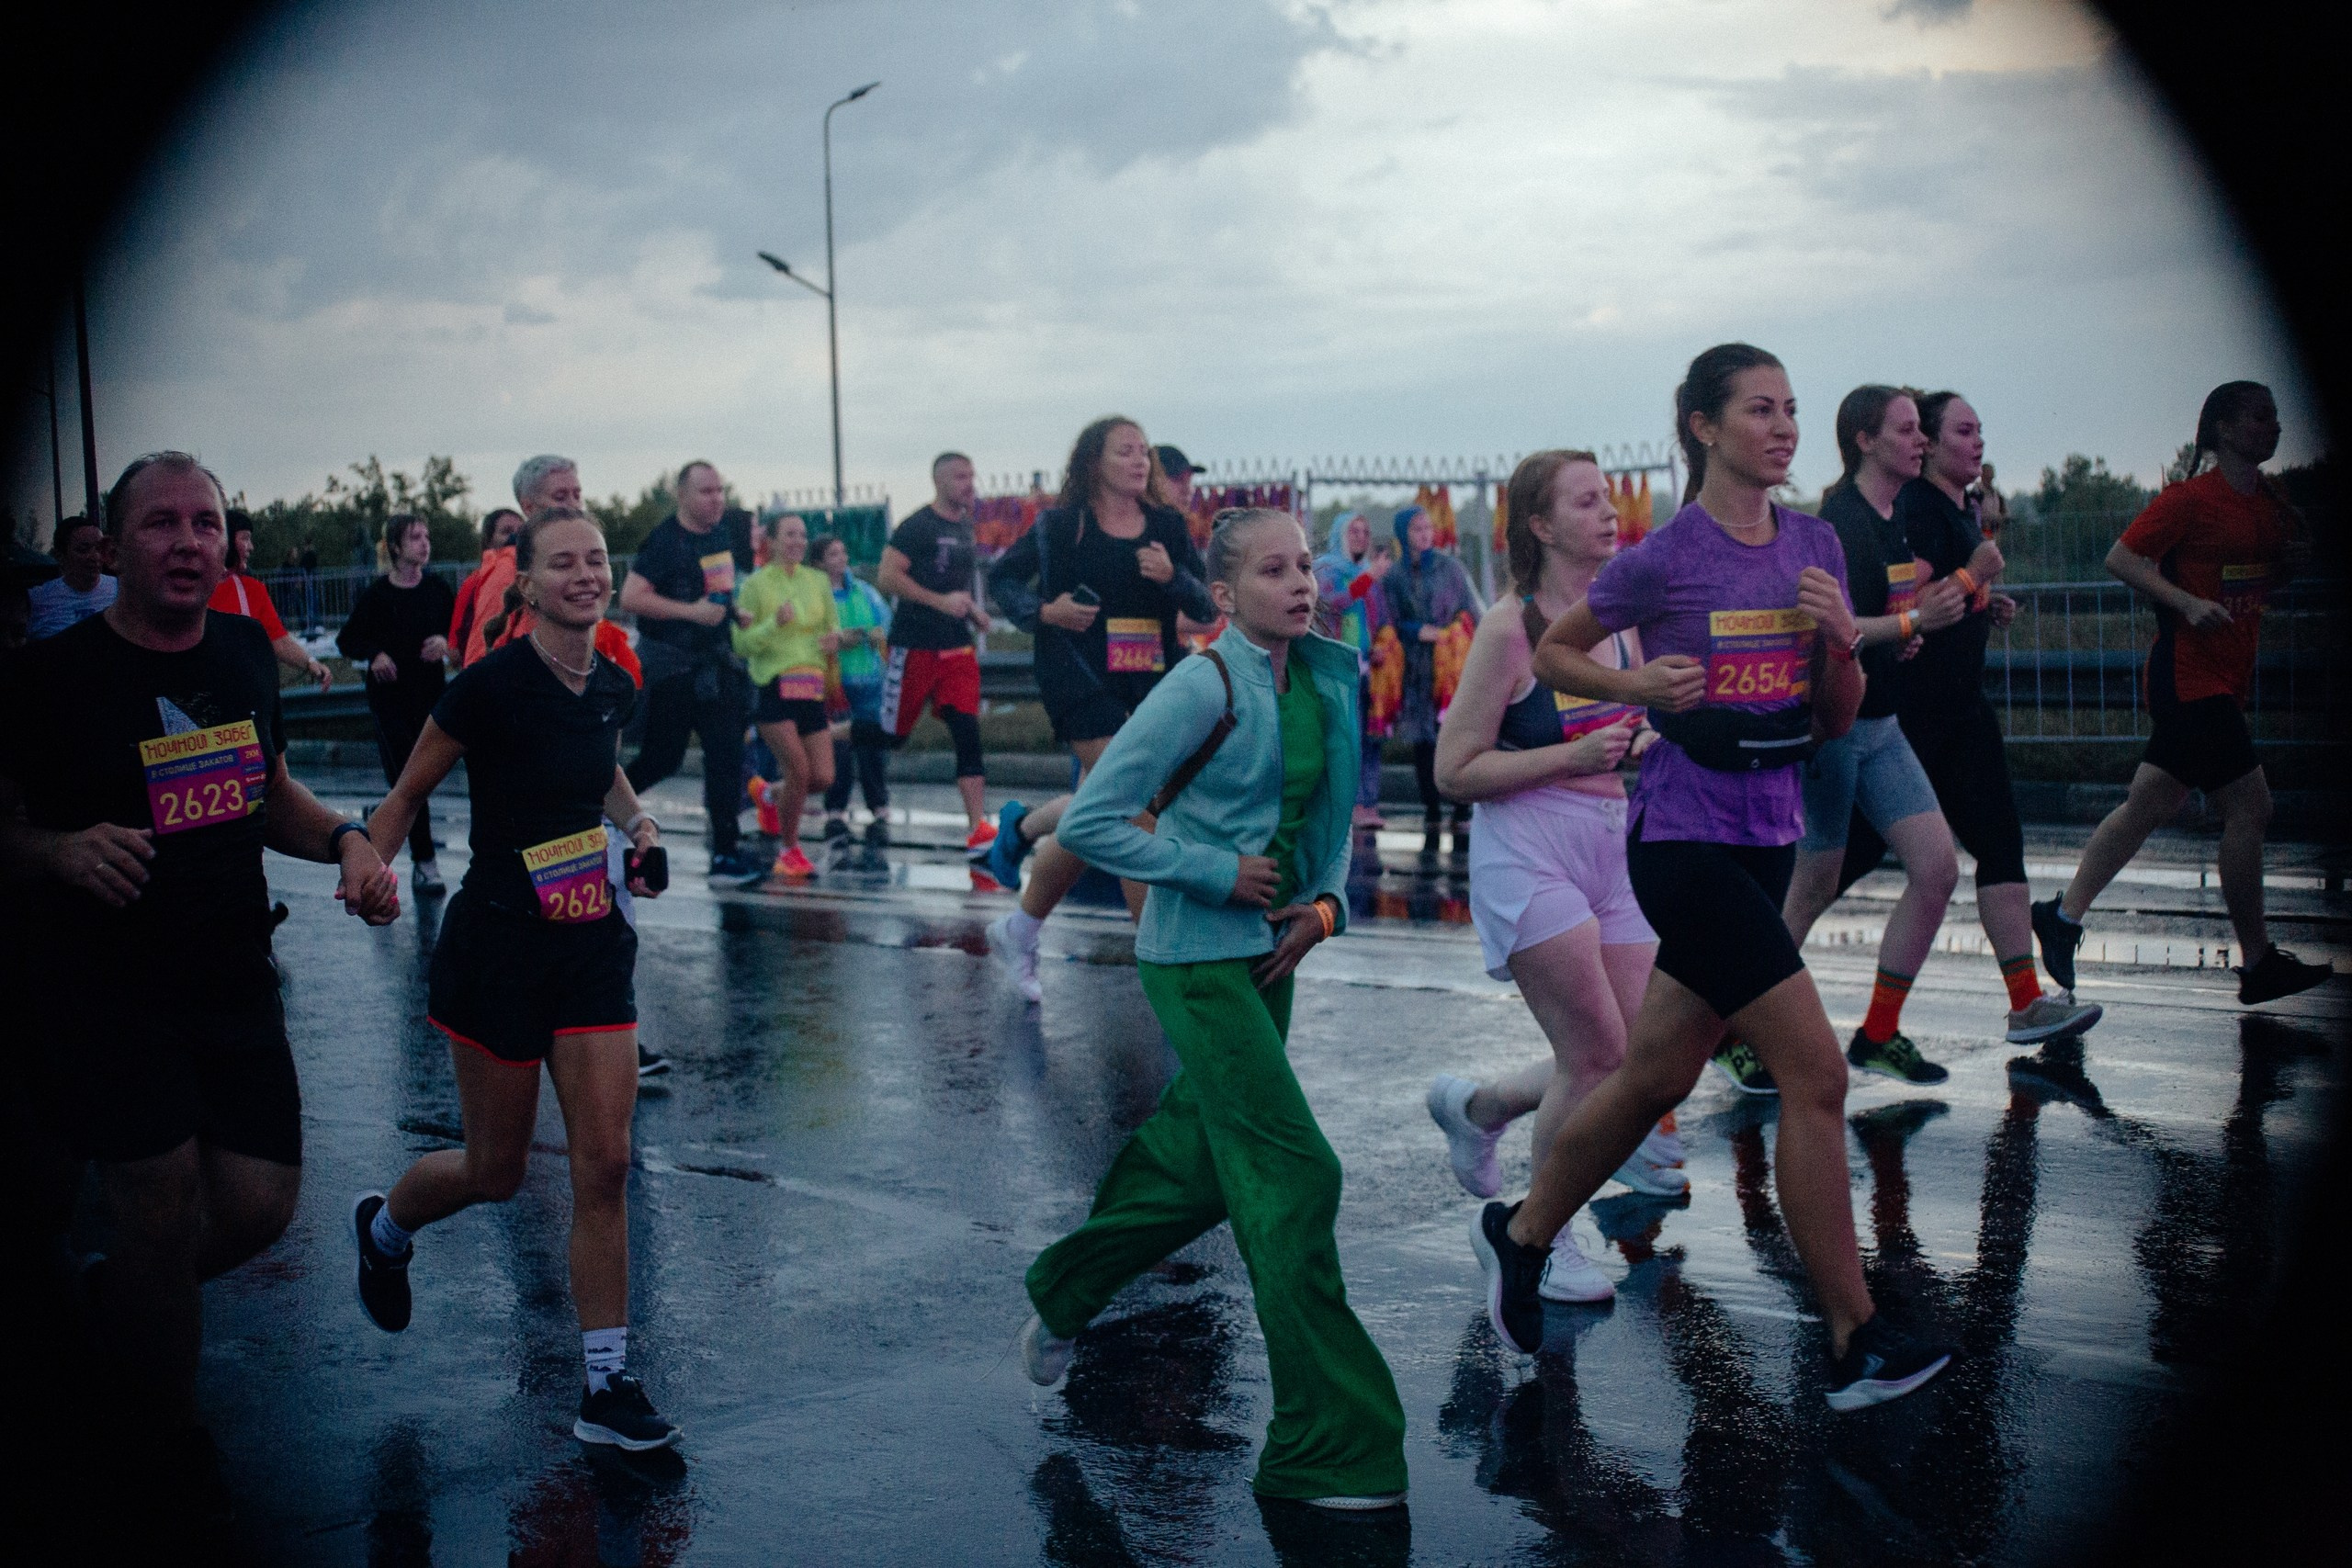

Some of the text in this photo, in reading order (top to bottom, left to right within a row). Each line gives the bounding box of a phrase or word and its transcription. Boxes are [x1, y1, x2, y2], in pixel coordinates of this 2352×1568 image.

[1715, 661, 1790, 695] 2654
[147, 724, 252, 760] НОЧНОЙ ЗАБЕГ
[198, 753, 234, 769] ЗАКАТОВ
[159, 778, 244, 827] 2623
[528, 837, 584, 864] НОЧНОЙ
[547, 878, 607, 921] 2624
